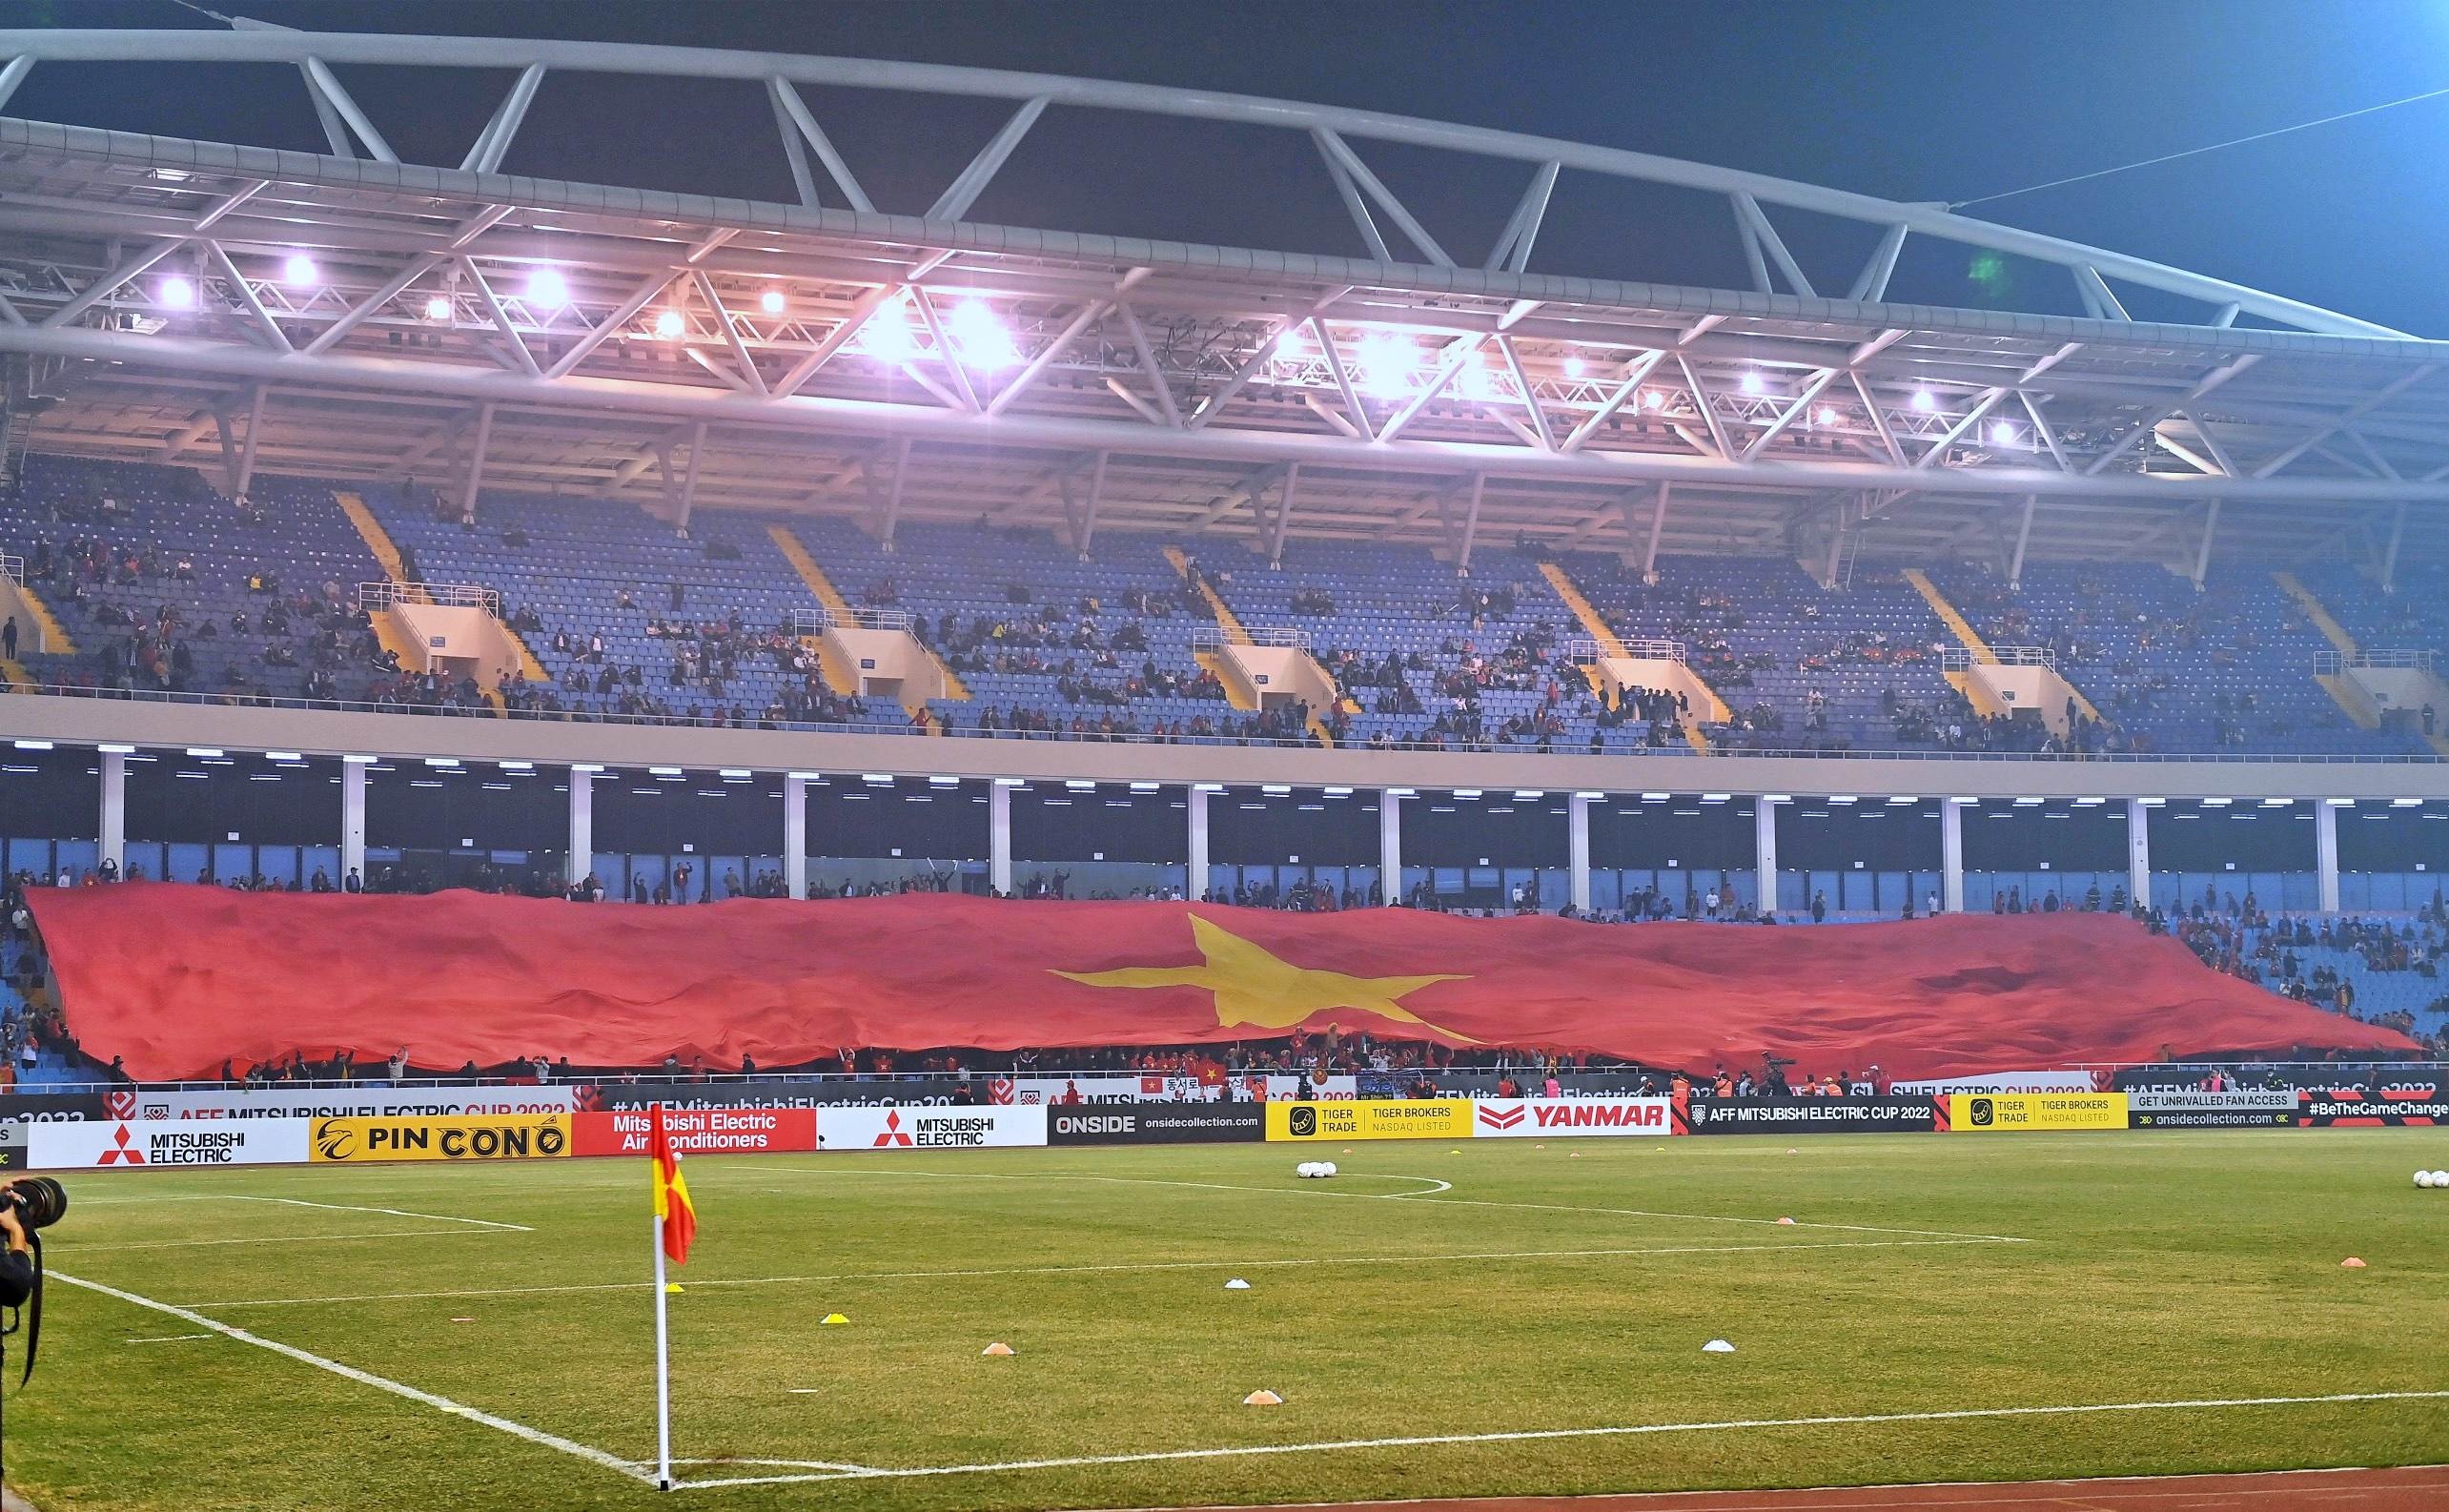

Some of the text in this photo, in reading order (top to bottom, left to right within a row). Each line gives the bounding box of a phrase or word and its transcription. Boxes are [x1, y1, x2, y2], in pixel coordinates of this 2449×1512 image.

[1998, 1101, 2026, 1111] TIGER
[2041, 1100, 2109, 1110] TIGER BROKERS
[2138, 1094, 2288, 1107] GET UNRIVALLED FAN ACCESS
[1322, 1109, 1354, 1119] TIGER
[1373, 1107, 1451, 1118] TIGER BROKERS
[1533, 1105, 1664, 1128] YANMAR
[1710, 1106, 1930, 1122] AFF MITSUBISHI ELECTRIC CUP 2022
[1998, 1113, 2029, 1123] TRADE
[2041, 1113, 2110, 1123] NASDAQ LISTED
[2156, 1113, 2273, 1125] onsidecollection.com
[613, 1113, 777, 1133] Mitsbishi Electric
[916, 1118, 994, 1133] MITSUBISHI
[1055, 1115, 1258, 1134] ONSIDE onsidecollection.com
[1322, 1122, 1357, 1133] TRADE
[1373, 1121, 1451, 1133] NASDAQ LISTED
[151, 1132, 245, 1149] MITSUBISHI
[369, 1127, 428, 1150] PIN
[436, 1126, 530, 1158] CON
[622, 1132, 768, 1151] Air onditioners
[916, 1132, 984, 1147] ELECTRIC
[150, 1148, 233, 1164] ELECTRIC
